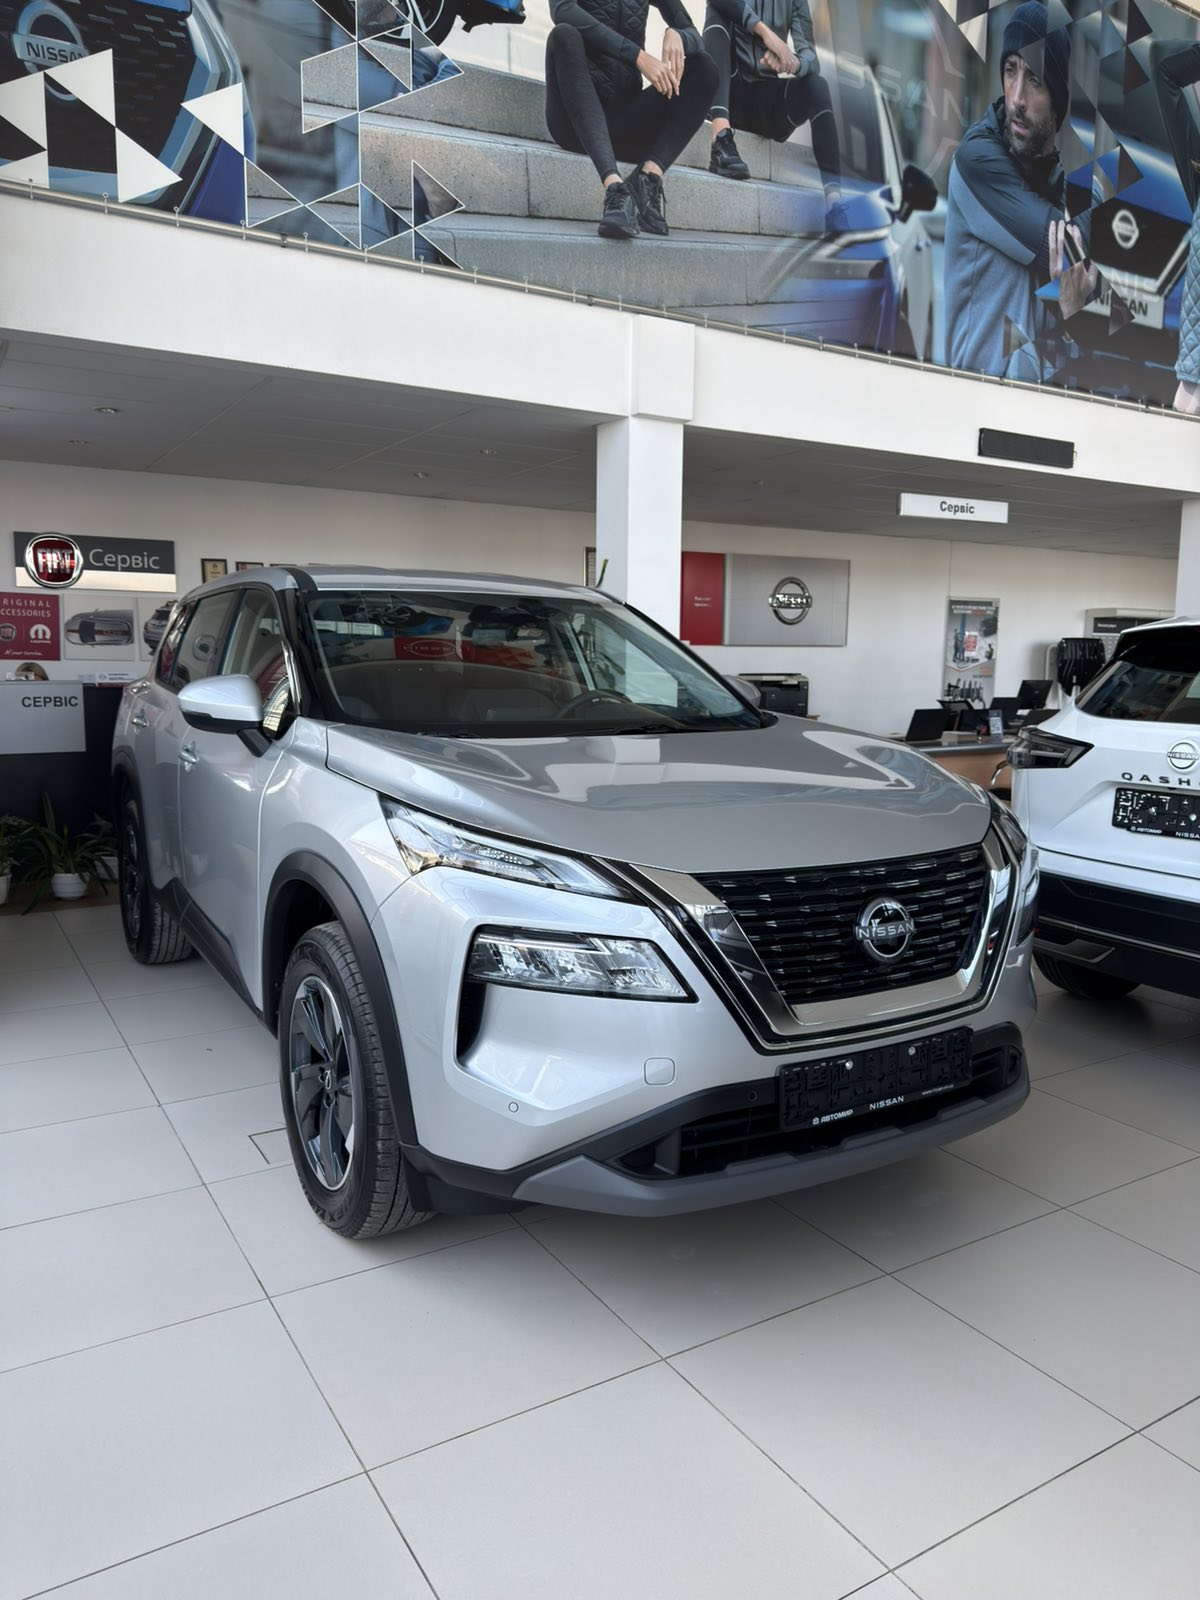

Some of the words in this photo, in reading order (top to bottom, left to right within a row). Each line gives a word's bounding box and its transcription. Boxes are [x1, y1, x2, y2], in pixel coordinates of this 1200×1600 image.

[940, 501, 975, 515] Сервіс
[37, 548, 74, 574] FIAT
[89, 549, 160, 571] Сервіс
[21, 696, 79, 708] СЕРВІС
[1167, 752, 1199, 761] NISSAN
[1121, 772, 1200, 787] QASH
[859, 923, 914, 939] NISSAN
[869, 1096, 904, 1110] NISSAN
[821, 1109, 853, 1123] АВТОМИР
